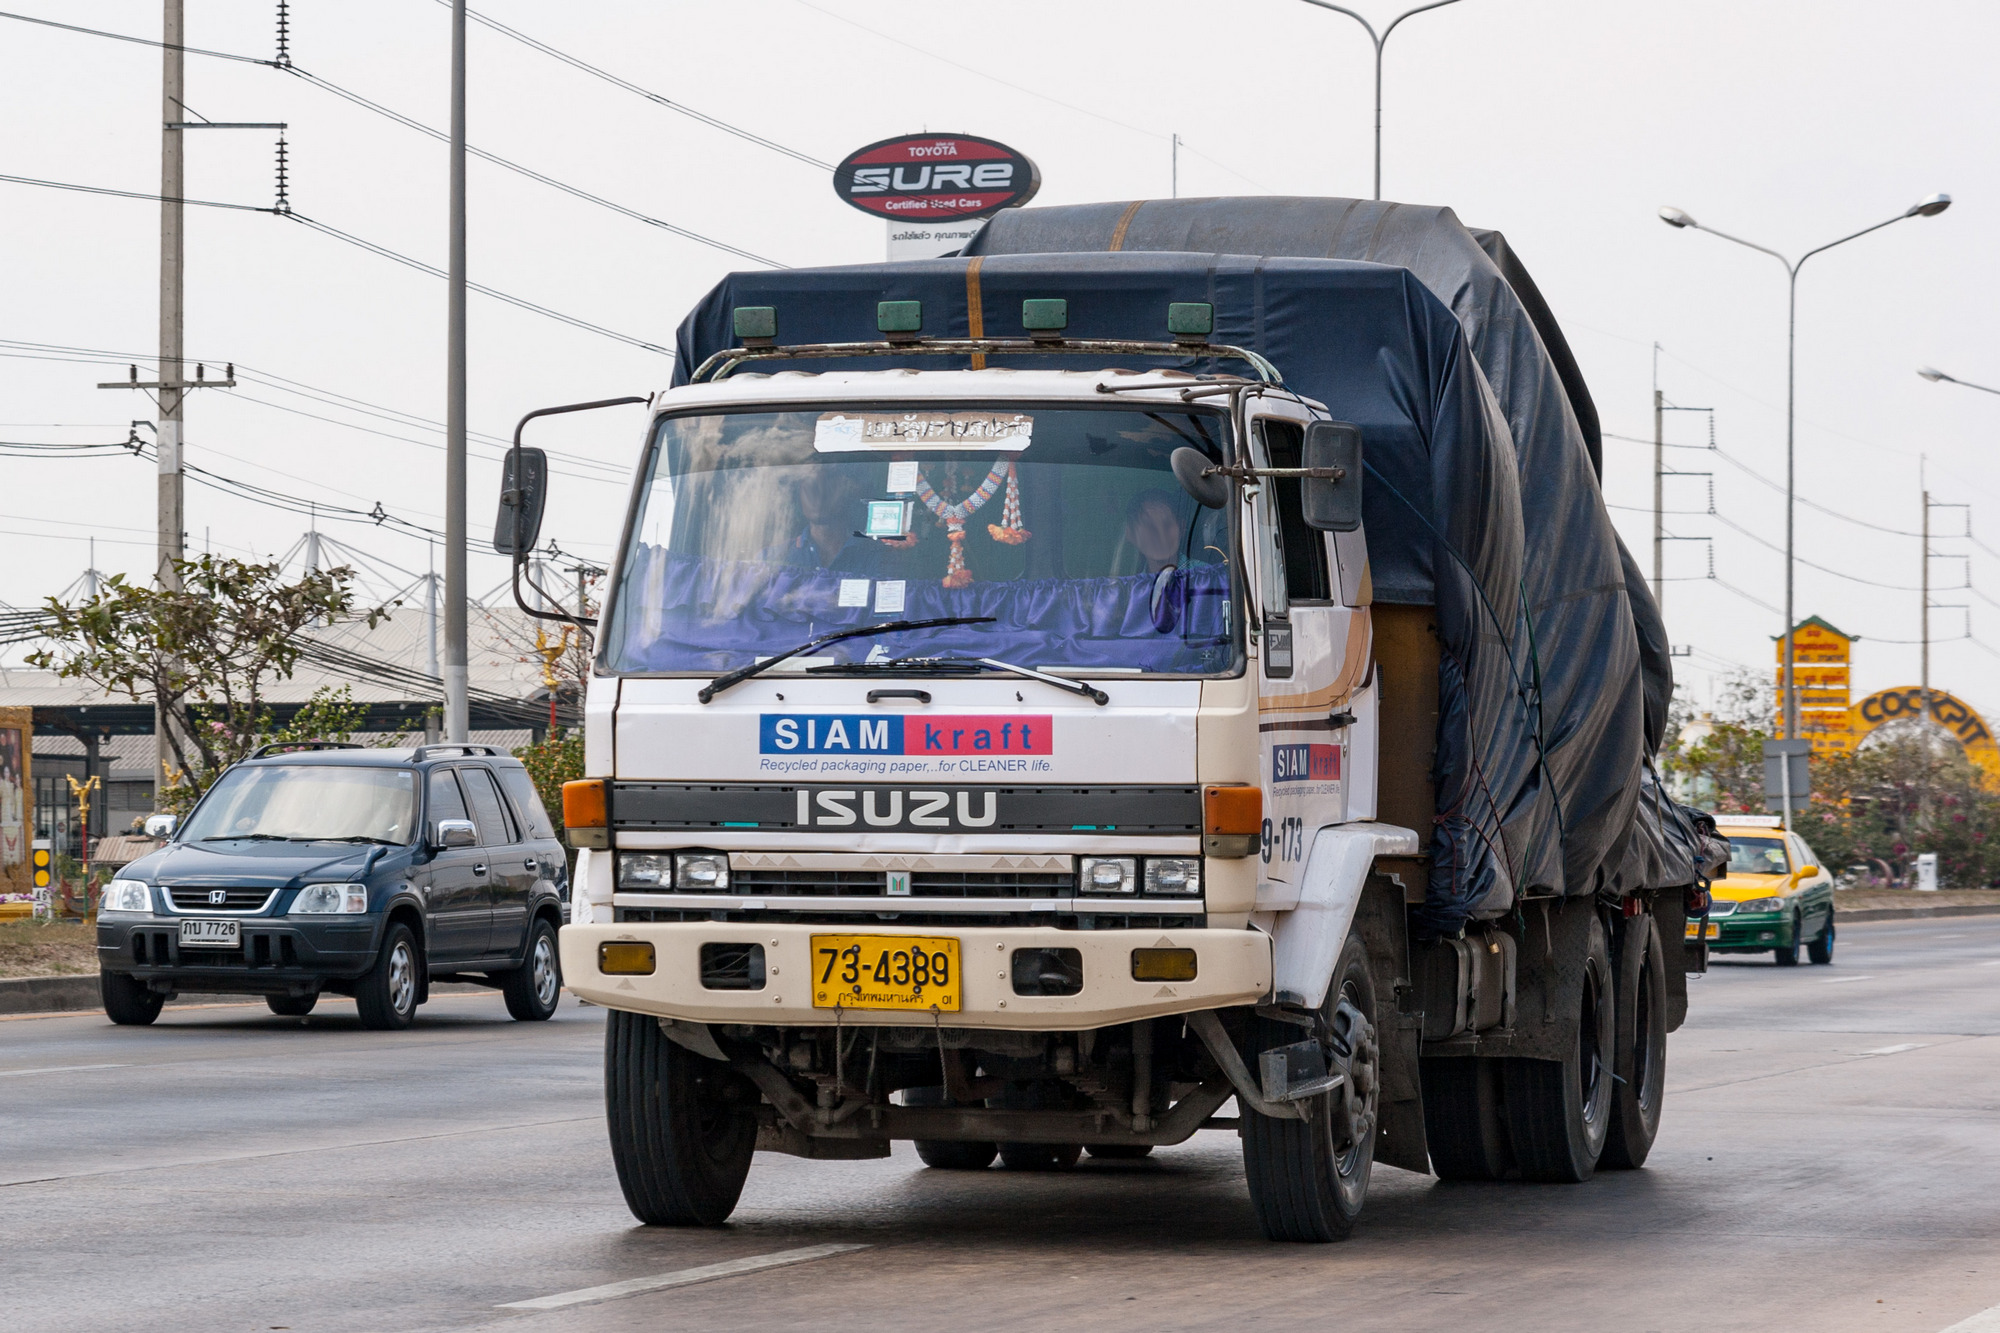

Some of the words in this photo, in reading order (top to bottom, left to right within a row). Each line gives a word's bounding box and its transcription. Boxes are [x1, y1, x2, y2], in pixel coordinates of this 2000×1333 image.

[908, 146, 958, 157] TOYOTA
[885, 200, 928, 210] Certified
[958, 198, 982, 207] Cars
[775, 719, 889, 750] SIAM
[925, 723, 1032, 750] kraft
[760, 759, 818, 773] Recycled
[821, 760, 886, 774] packaging
[959, 760, 1027, 772] CLEANER
[1277, 749, 1307, 777] SIAM
[1313, 751, 1337, 775] kraft
[797, 790, 997, 827] ISUZU
[206, 922, 235, 935] 7726
[819, 948, 949, 987] 73-4389
